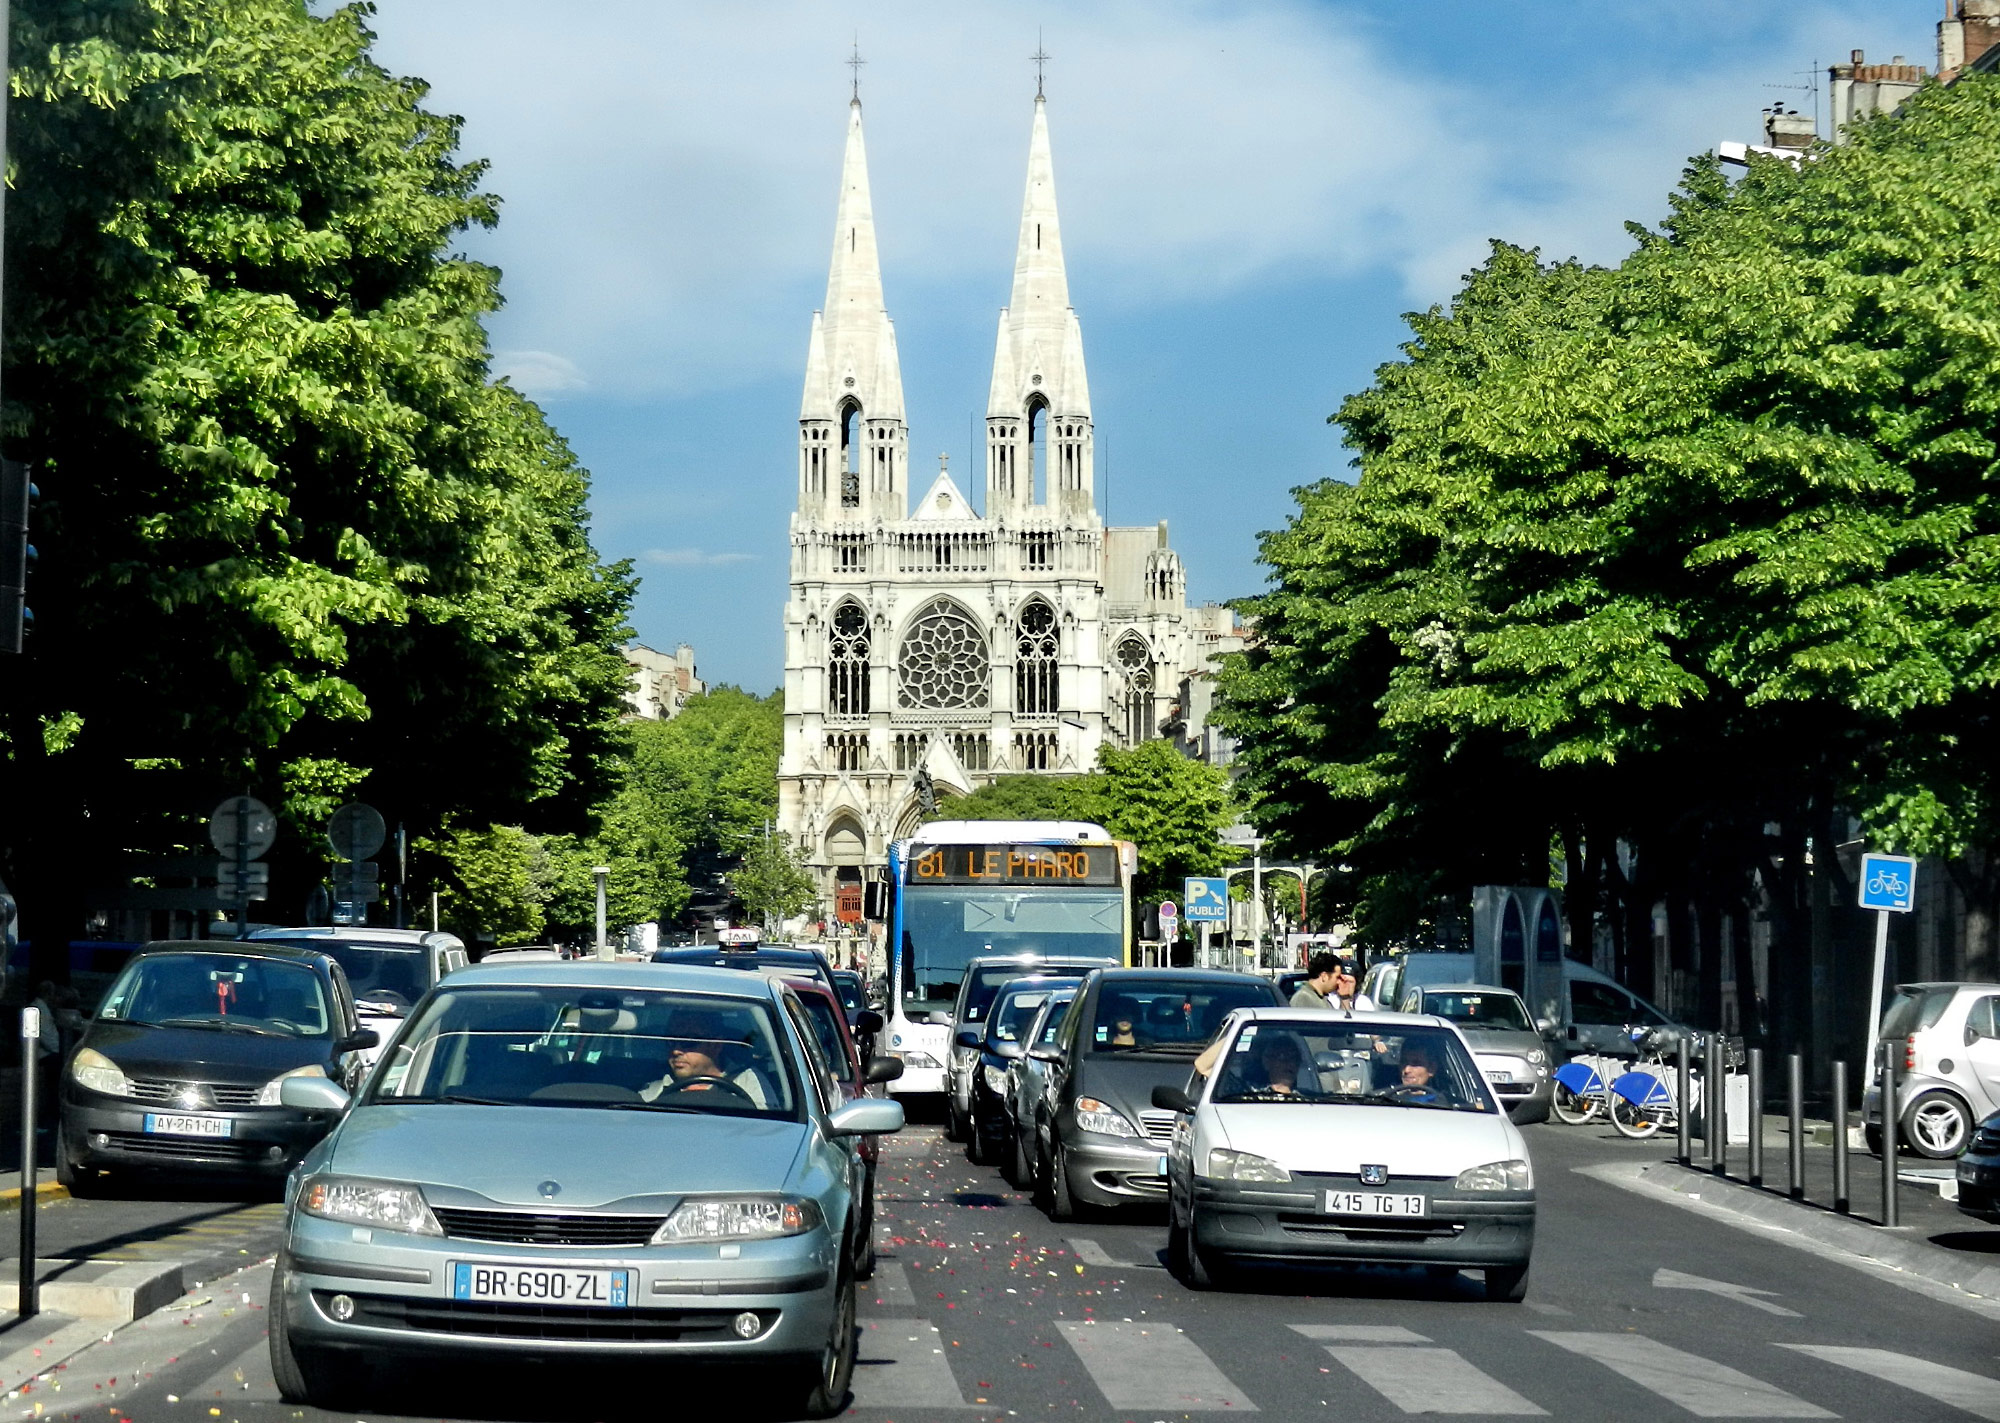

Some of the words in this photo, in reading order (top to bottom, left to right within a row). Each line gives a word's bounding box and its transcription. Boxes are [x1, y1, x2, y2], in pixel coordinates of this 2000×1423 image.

[917, 851, 946, 877] 81
[968, 851, 1001, 878] LE
[1007, 851, 1089, 878] PHARO
[1187, 881, 1208, 904] P
[1188, 906, 1225, 916] PUBLIC
[727, 932, 752, 941] TAXI
[921, 1037, 945, 1046] 1317
[1332, 1194, 1362, 1212] 415
[1373, 1195, 1393, 1213] TG
[1403, 1197, 1421, 1214] 13
[475, 1269, 607, 1301] BR-690-ZL
[612, 1289, 625, 1303] 13
